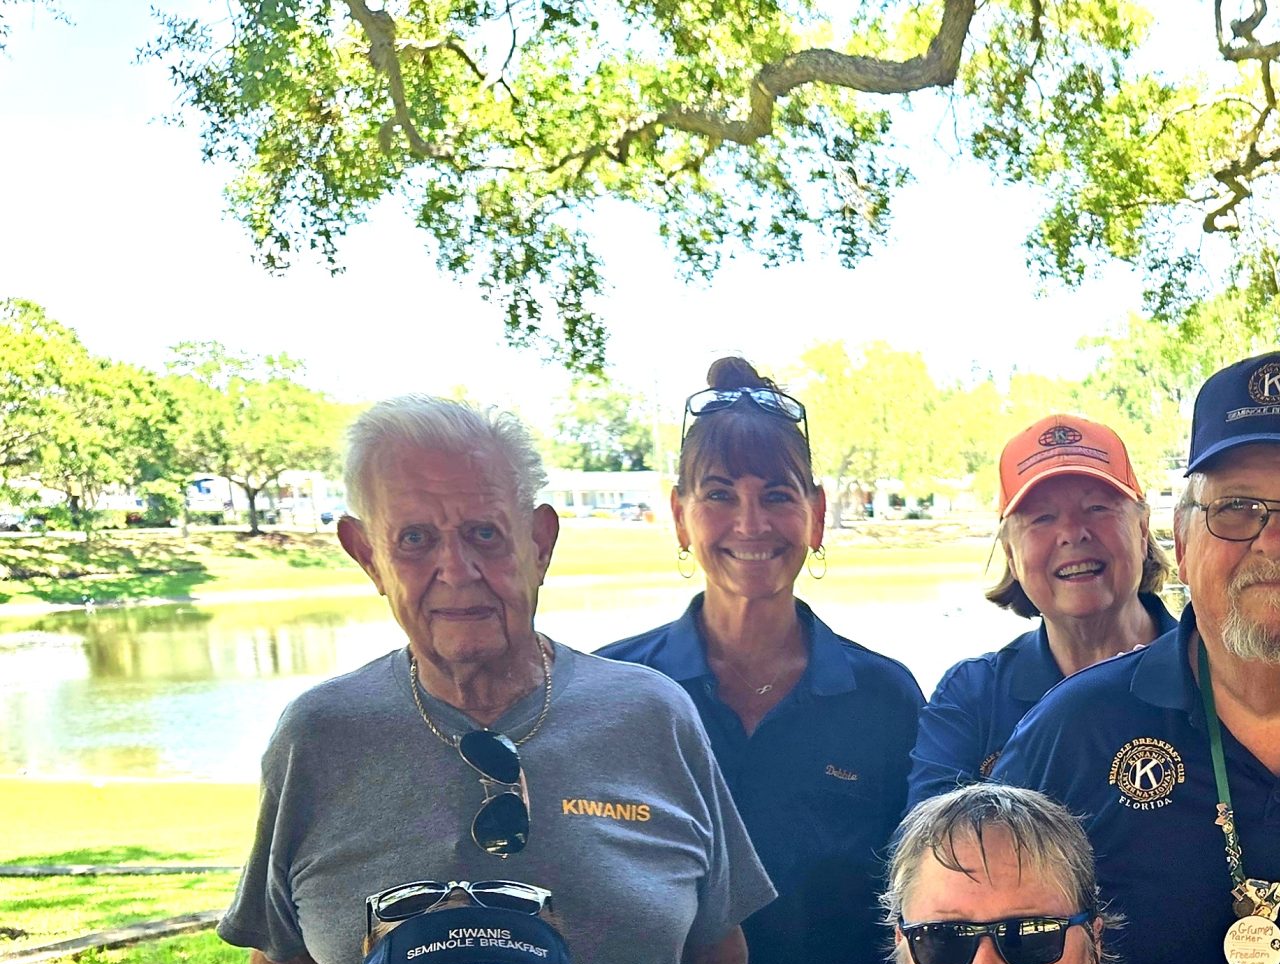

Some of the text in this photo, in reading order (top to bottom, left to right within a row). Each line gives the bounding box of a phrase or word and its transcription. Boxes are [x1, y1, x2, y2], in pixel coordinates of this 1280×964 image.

[1128, 751, 1165, 765] KIWANIS
[1132, 738, 1181, 762] BREAKFAST
[1134, 758, 1159, 789] K
[1122, 769, 1171, 798] INTERNATIONAL
[562, 798, 650, 822] KIWANIS
[1119, 796, 1172, 810] FLORIDA
[449, 928, 510, 939] KIWANIS
[1229, 930, 1262, 942] Parker
[407, 938, 548, 960] SEMINOLE BREAKFAST
[1230, 949, 1269, 959] Freedom
